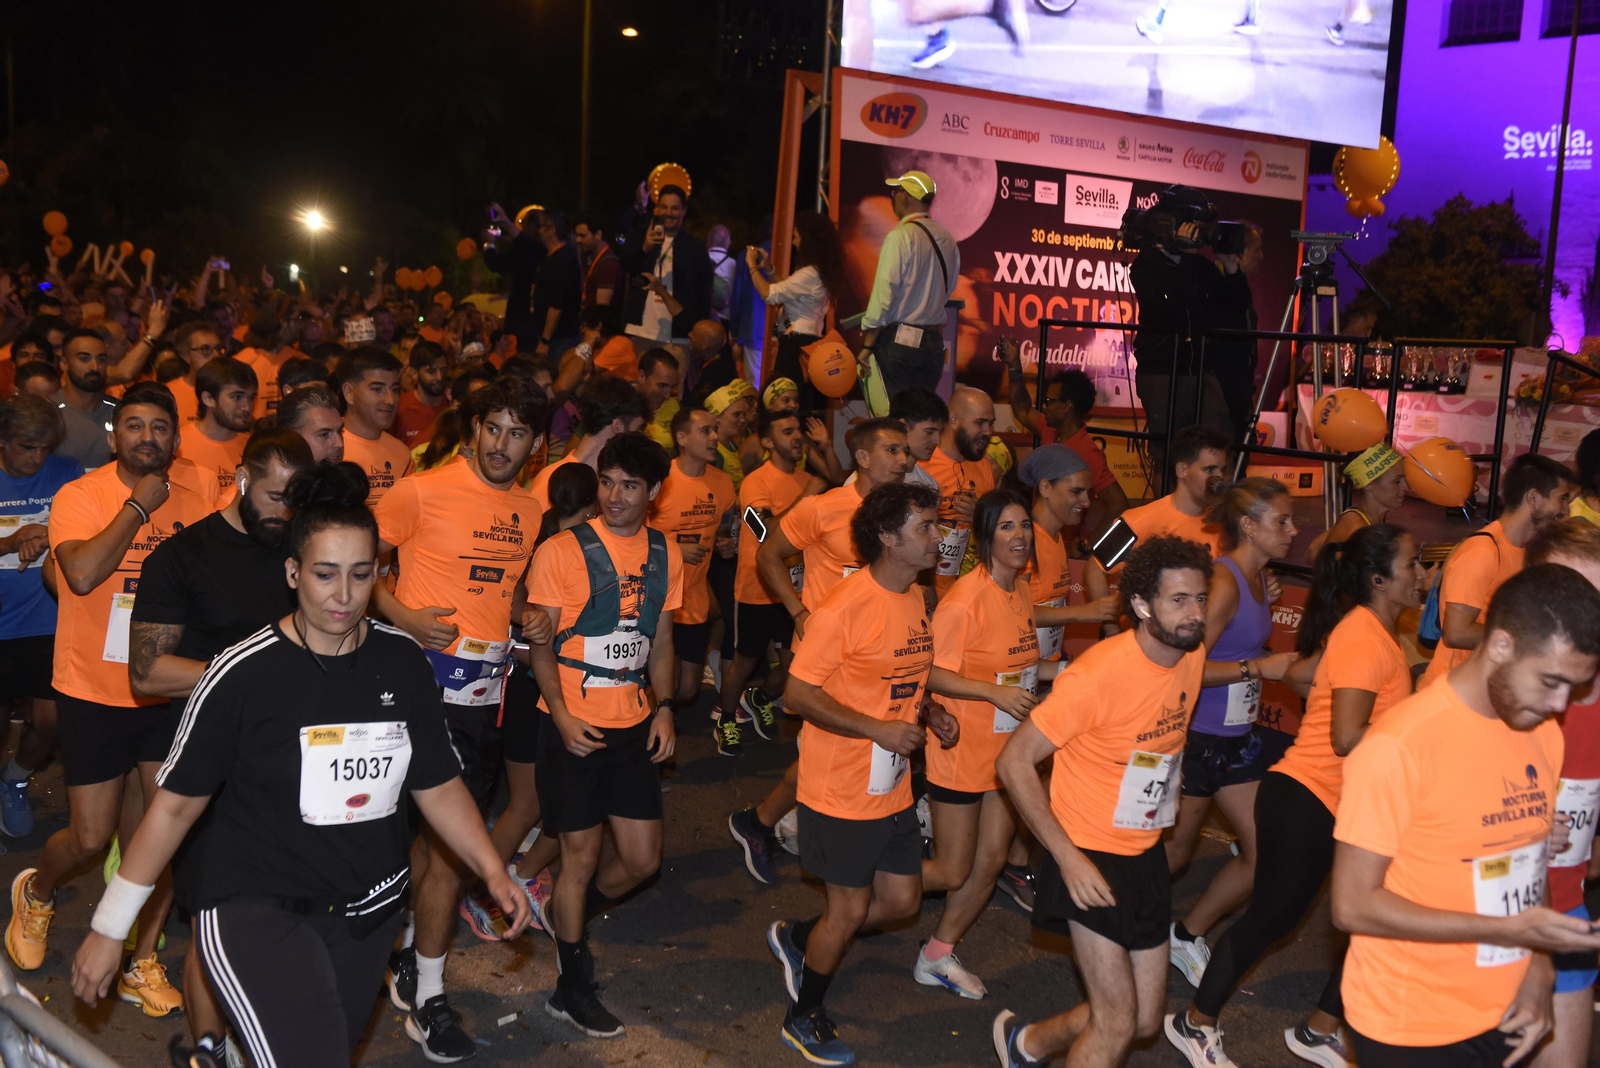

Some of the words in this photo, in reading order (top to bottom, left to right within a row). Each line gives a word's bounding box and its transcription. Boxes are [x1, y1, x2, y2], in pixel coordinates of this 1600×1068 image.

[941, 112, 970, 129] ABC
[984, 121, 1041, 144] Cruzcampo
[1050, 134, 1074, 147] TORRE
[1075, 138, 1106, 151] SEVILLA
[1156, 142, 1173, 153] Avisa
[1014, 178, 1029, 189] IMD
[1031, 228, 1045, 243] 30
[1047, 230, 1061, 245] de
[1063, 233, 1123, 251] septiembe
[993, 251, 1074, 288] XXXIV
[1076, 258, 1136, 293] CARR
[992, 291, 1139, 335] NOCTUR
[1366, 451, 1399, 480] BARRE
[0, 498, 27, 508] arrera
[146, 535, 171, 543] NOCT
[473, 530, 507, 543] SEVILLA
[508, 535, 524, 546] KH7
[490, 525, 523, 537] NOCTURNA
[128, 542, 158, 551] SEVIL
[603, 641, 642, 659] 19937
[893, 645, 921, 657] SEVILLA
[1008, 643, 1031, 656] SEVILLA
[329, 756, 393, 781] 15037
[1502, 790, 1547, 807] NOCTURNA
[1481, 808, 1526, 827] SEVILLA
[1558, 808, 1595, 831] 504
